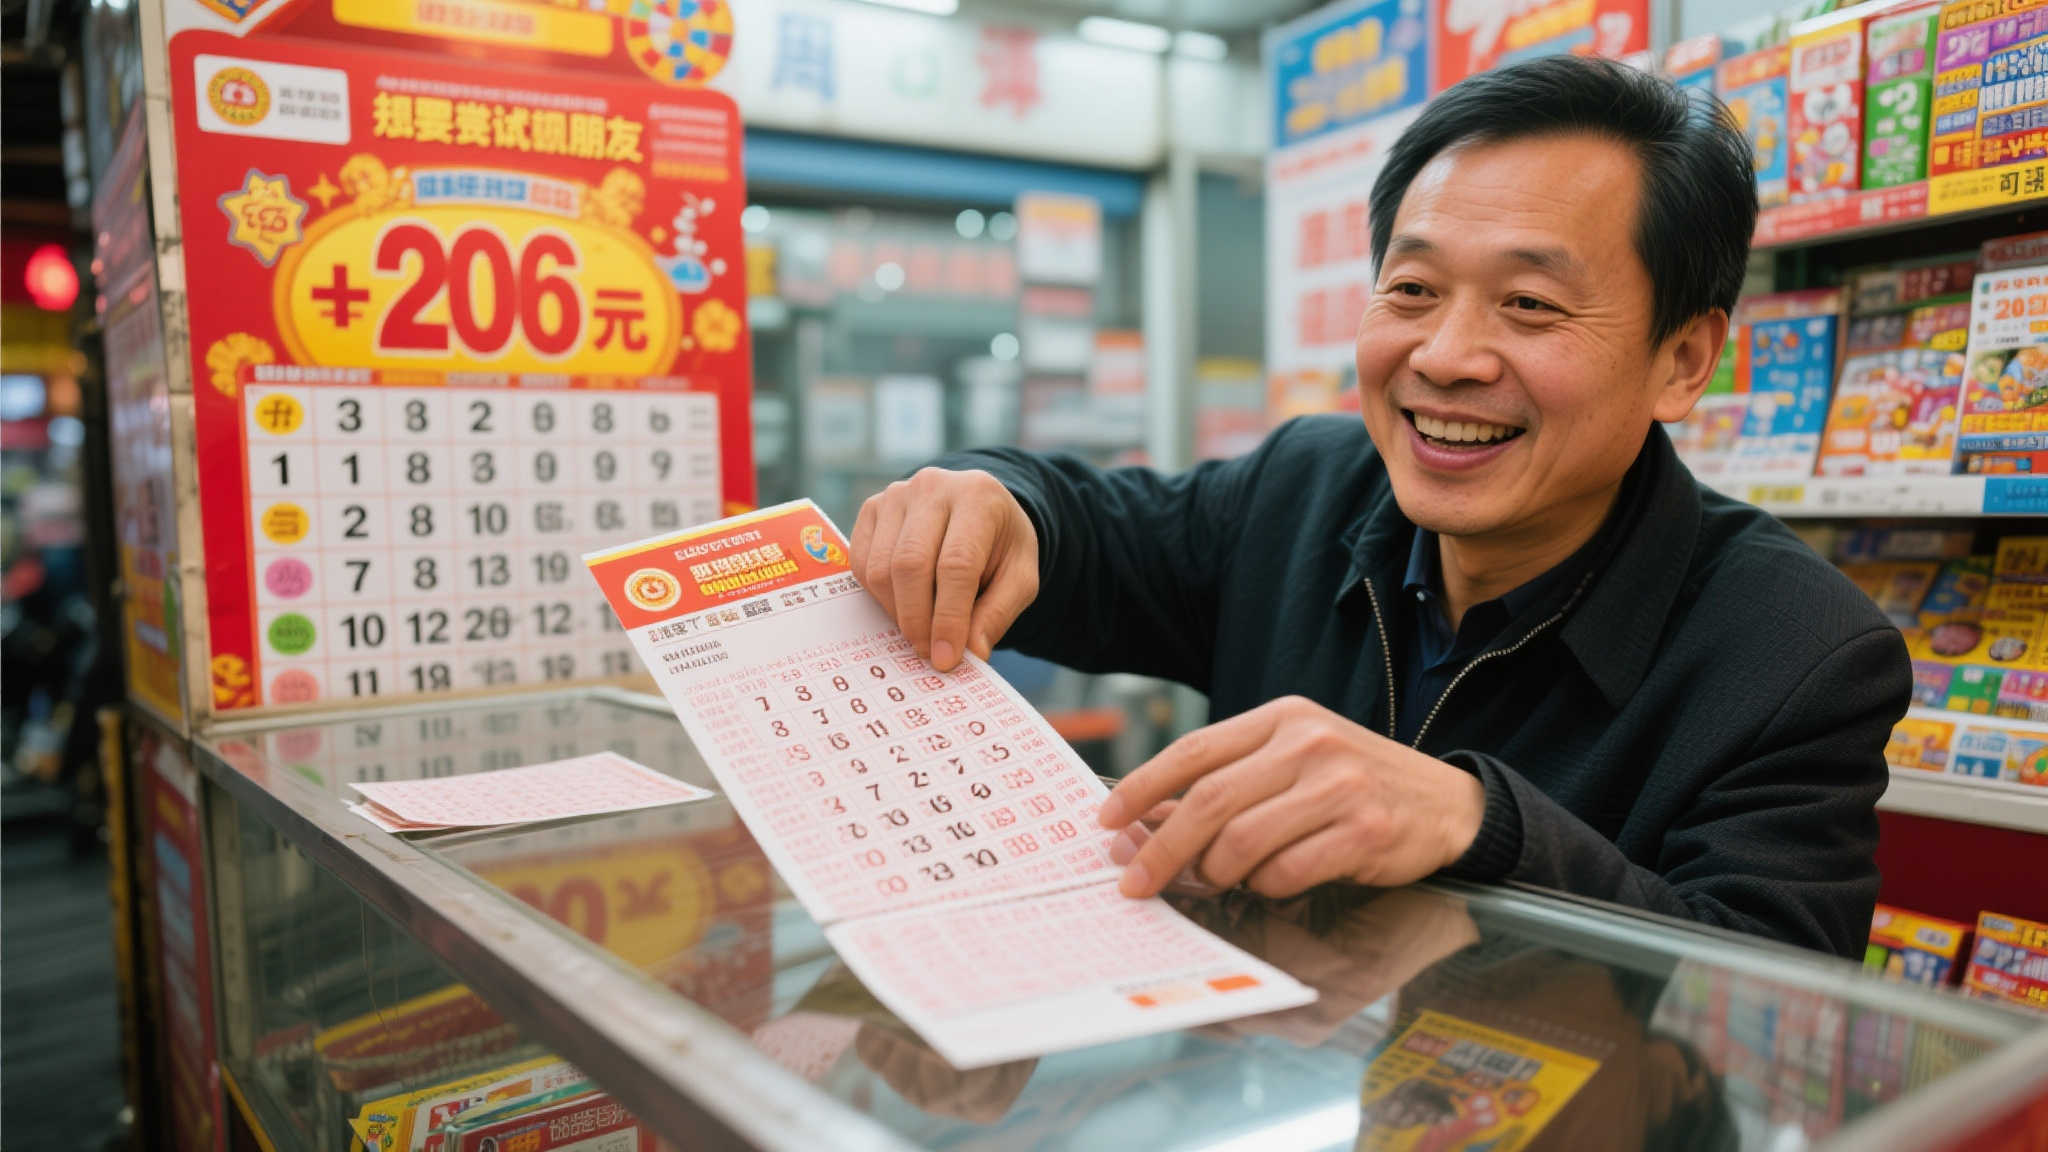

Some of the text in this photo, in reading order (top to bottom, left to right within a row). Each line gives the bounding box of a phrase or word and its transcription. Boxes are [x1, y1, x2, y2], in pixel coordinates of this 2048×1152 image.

[337, 398, 363, 433] 3
[469, 400, 493, 433] 2
[273, 453, 289, 486] 1
[343, 453, 359, 485] 1
[405, 451, 432, 485] 8
[343, 504, 369, 539] 2
[409, 504, 435, 538] 8
[468, 502, 509, 536] 10
[345, 559, 371, 593] 7
[413, 557, 438, 591] 8
[469, 554, 511, 588] 13
[341, 614, 386, 649] 10
[407, 610, 449, 645] 12
[532, 602, 573, 637] 12
[349, 669, 379, 698] 11
